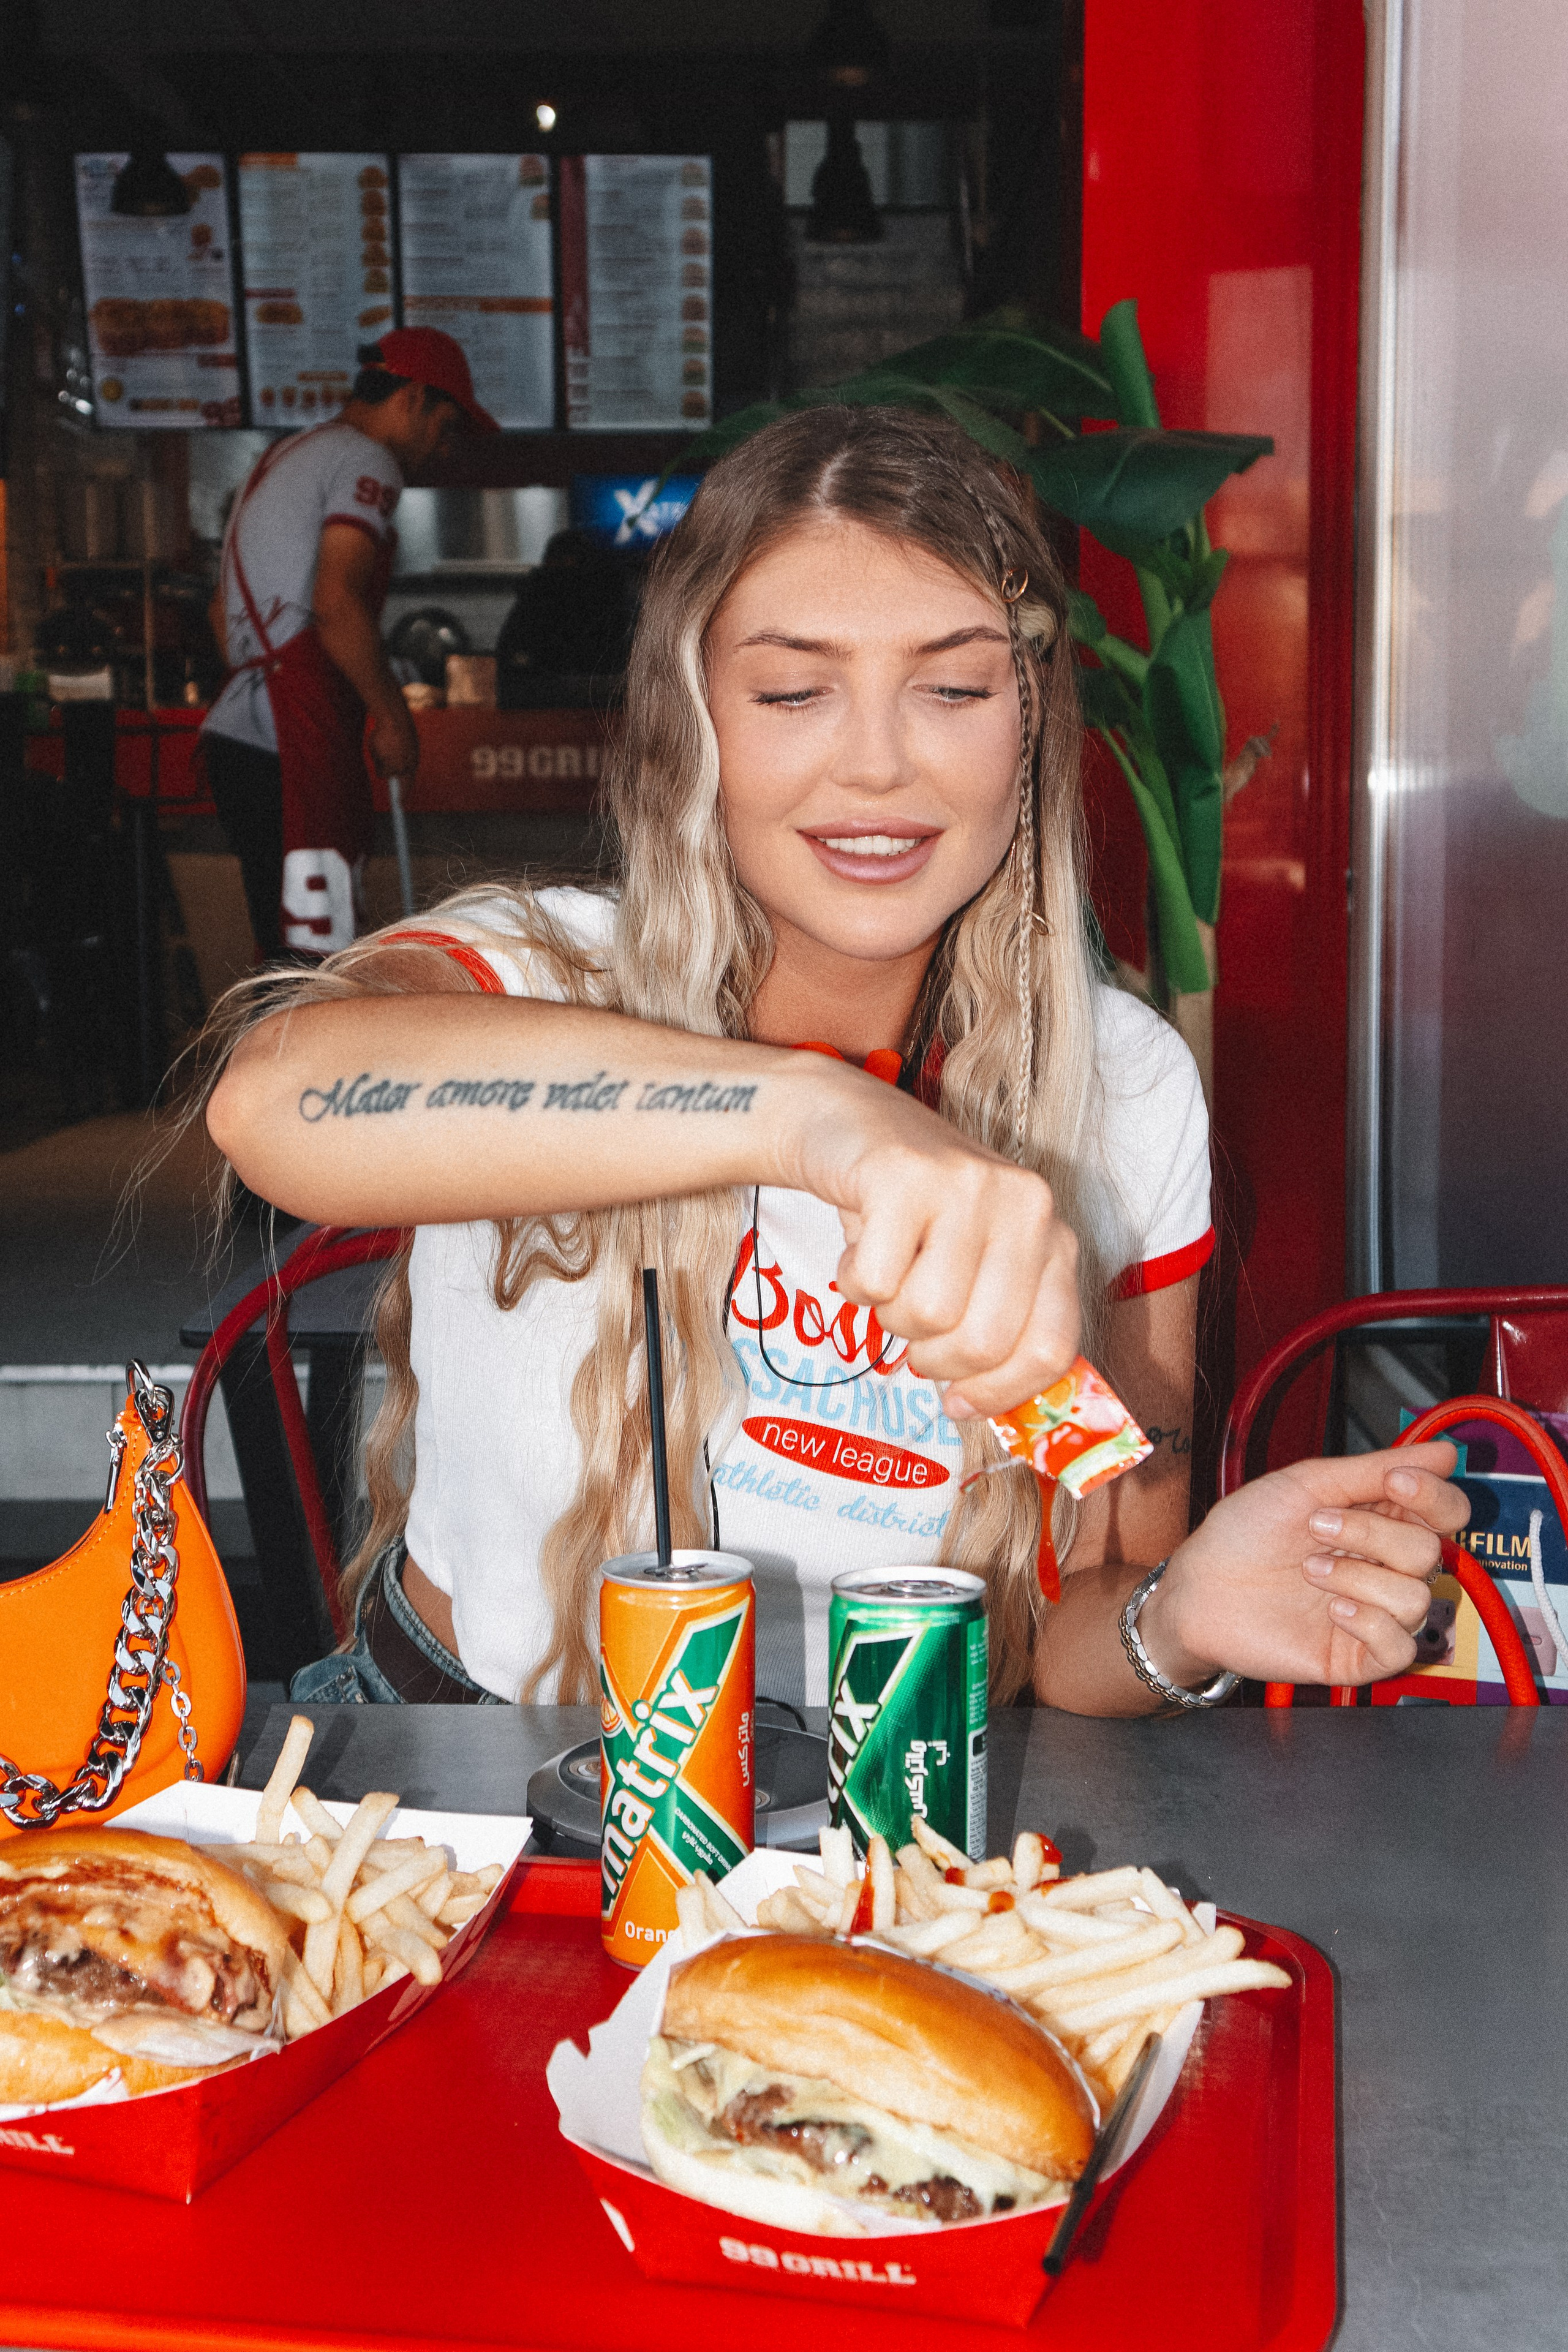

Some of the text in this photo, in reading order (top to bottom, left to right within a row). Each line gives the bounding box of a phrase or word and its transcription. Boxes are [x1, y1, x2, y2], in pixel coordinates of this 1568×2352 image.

[761, 1422, 928, 1484] new league
[712, 1461, 951, 1539] athletic district
[601, 1669, 718, 1896] matrix
[674, 1807, 733, 1873] CARBONATED SOFT DRINK
